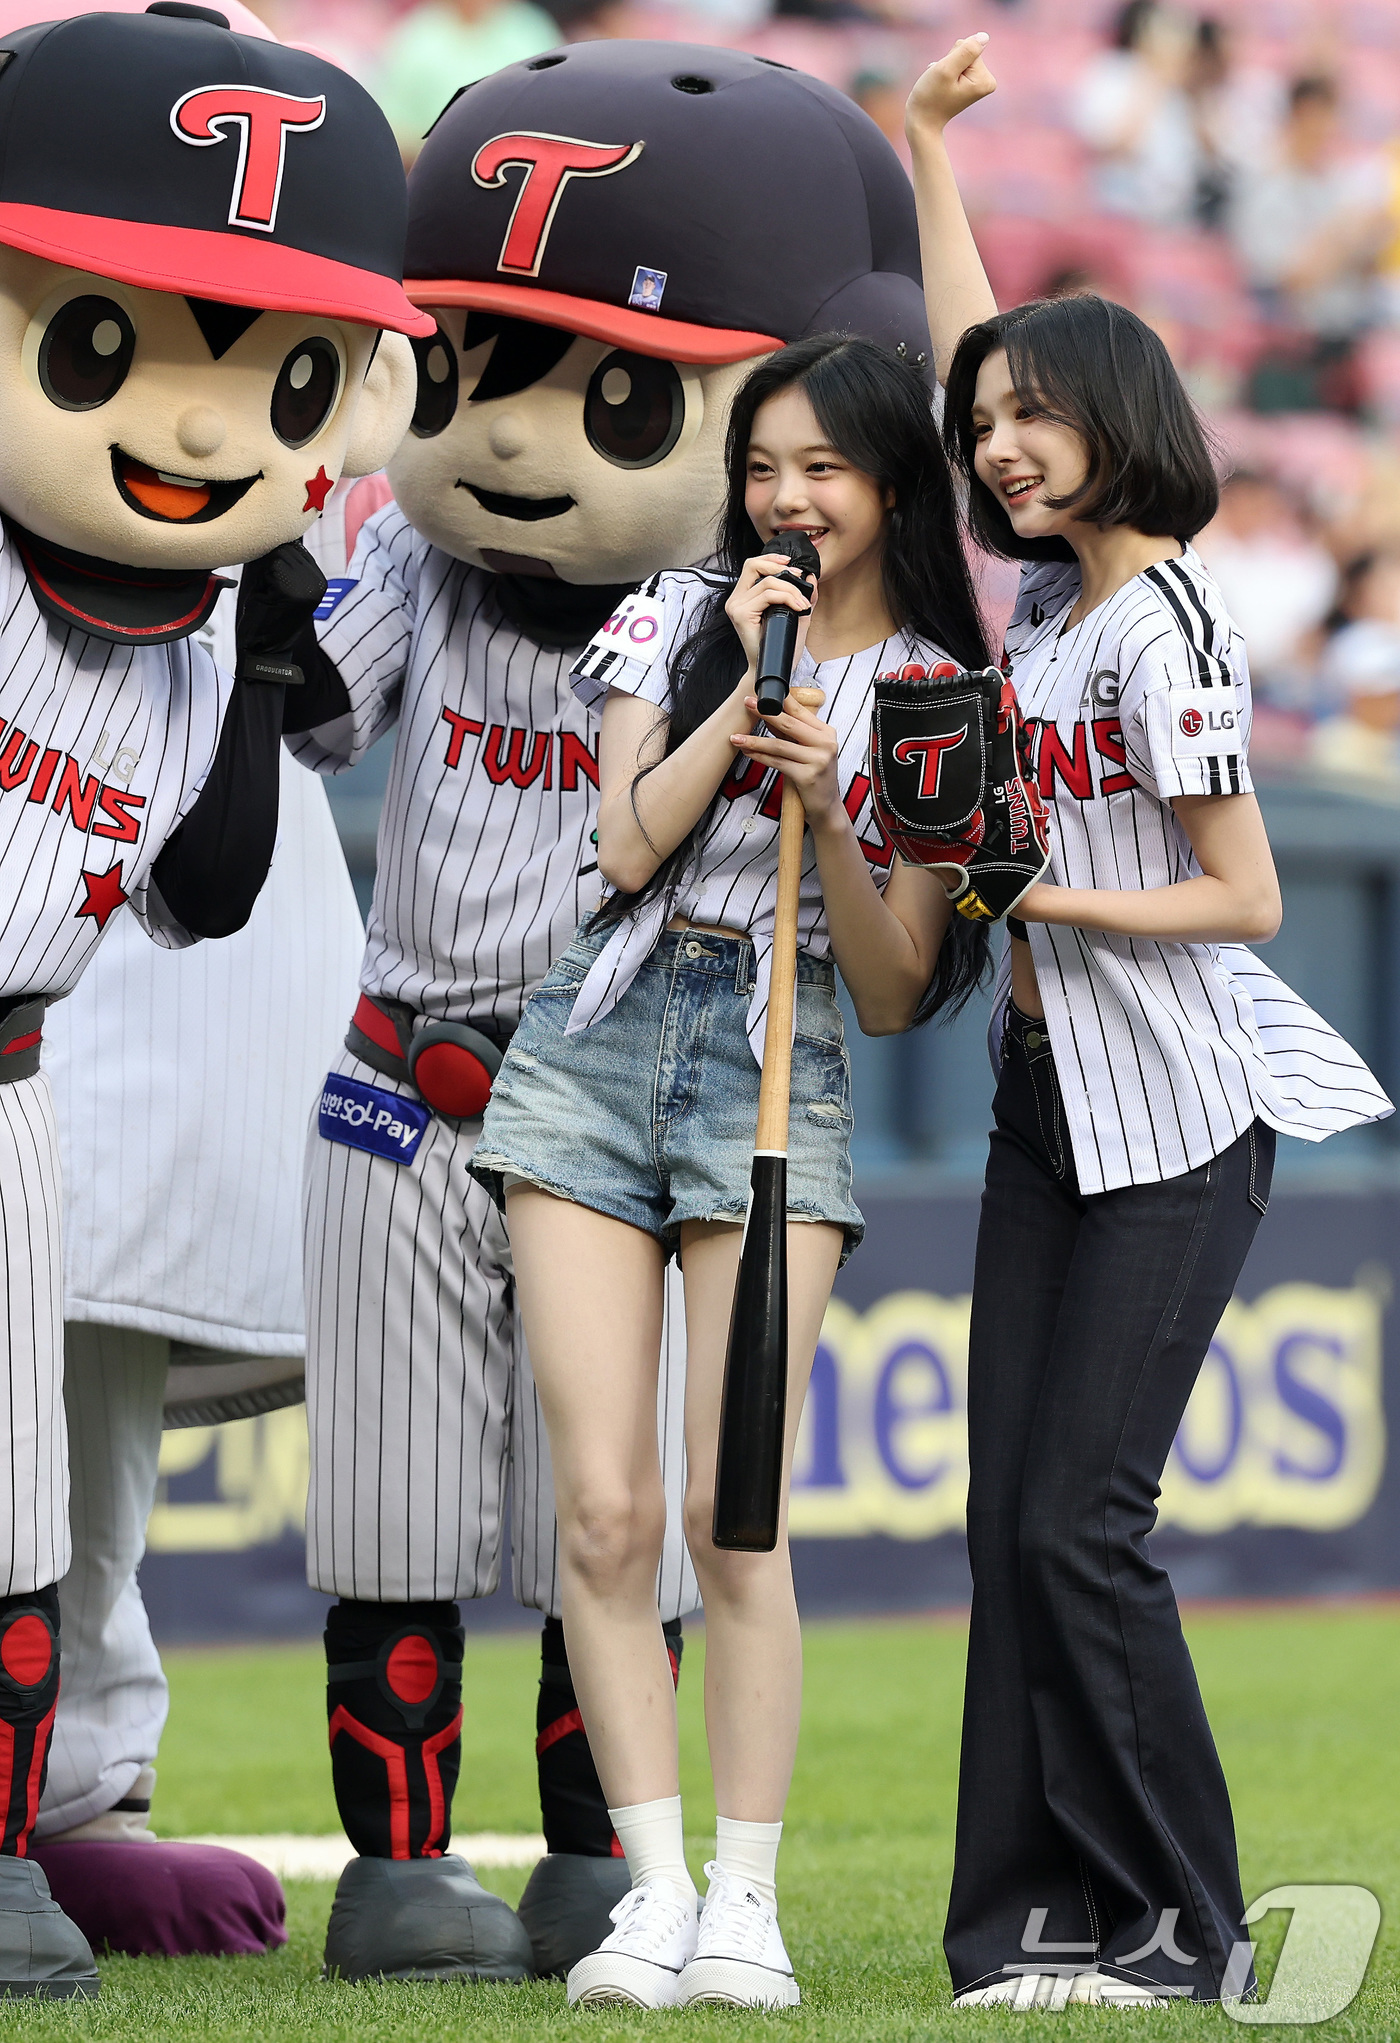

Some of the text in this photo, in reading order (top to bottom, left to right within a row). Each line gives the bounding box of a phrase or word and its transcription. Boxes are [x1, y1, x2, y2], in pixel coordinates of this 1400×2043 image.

[169, 83, 326, 233] T
[470, 130, 646, 278] T
[1078, 668, 1119, 707] LG
[1208, 710, 1234, 731] LG
[92, 729, 139, 784] LG
[892, 722, 969, 800] T
[993, 786, 1006, 804] LG
[1004, 776, 1029, 855] TWINS
